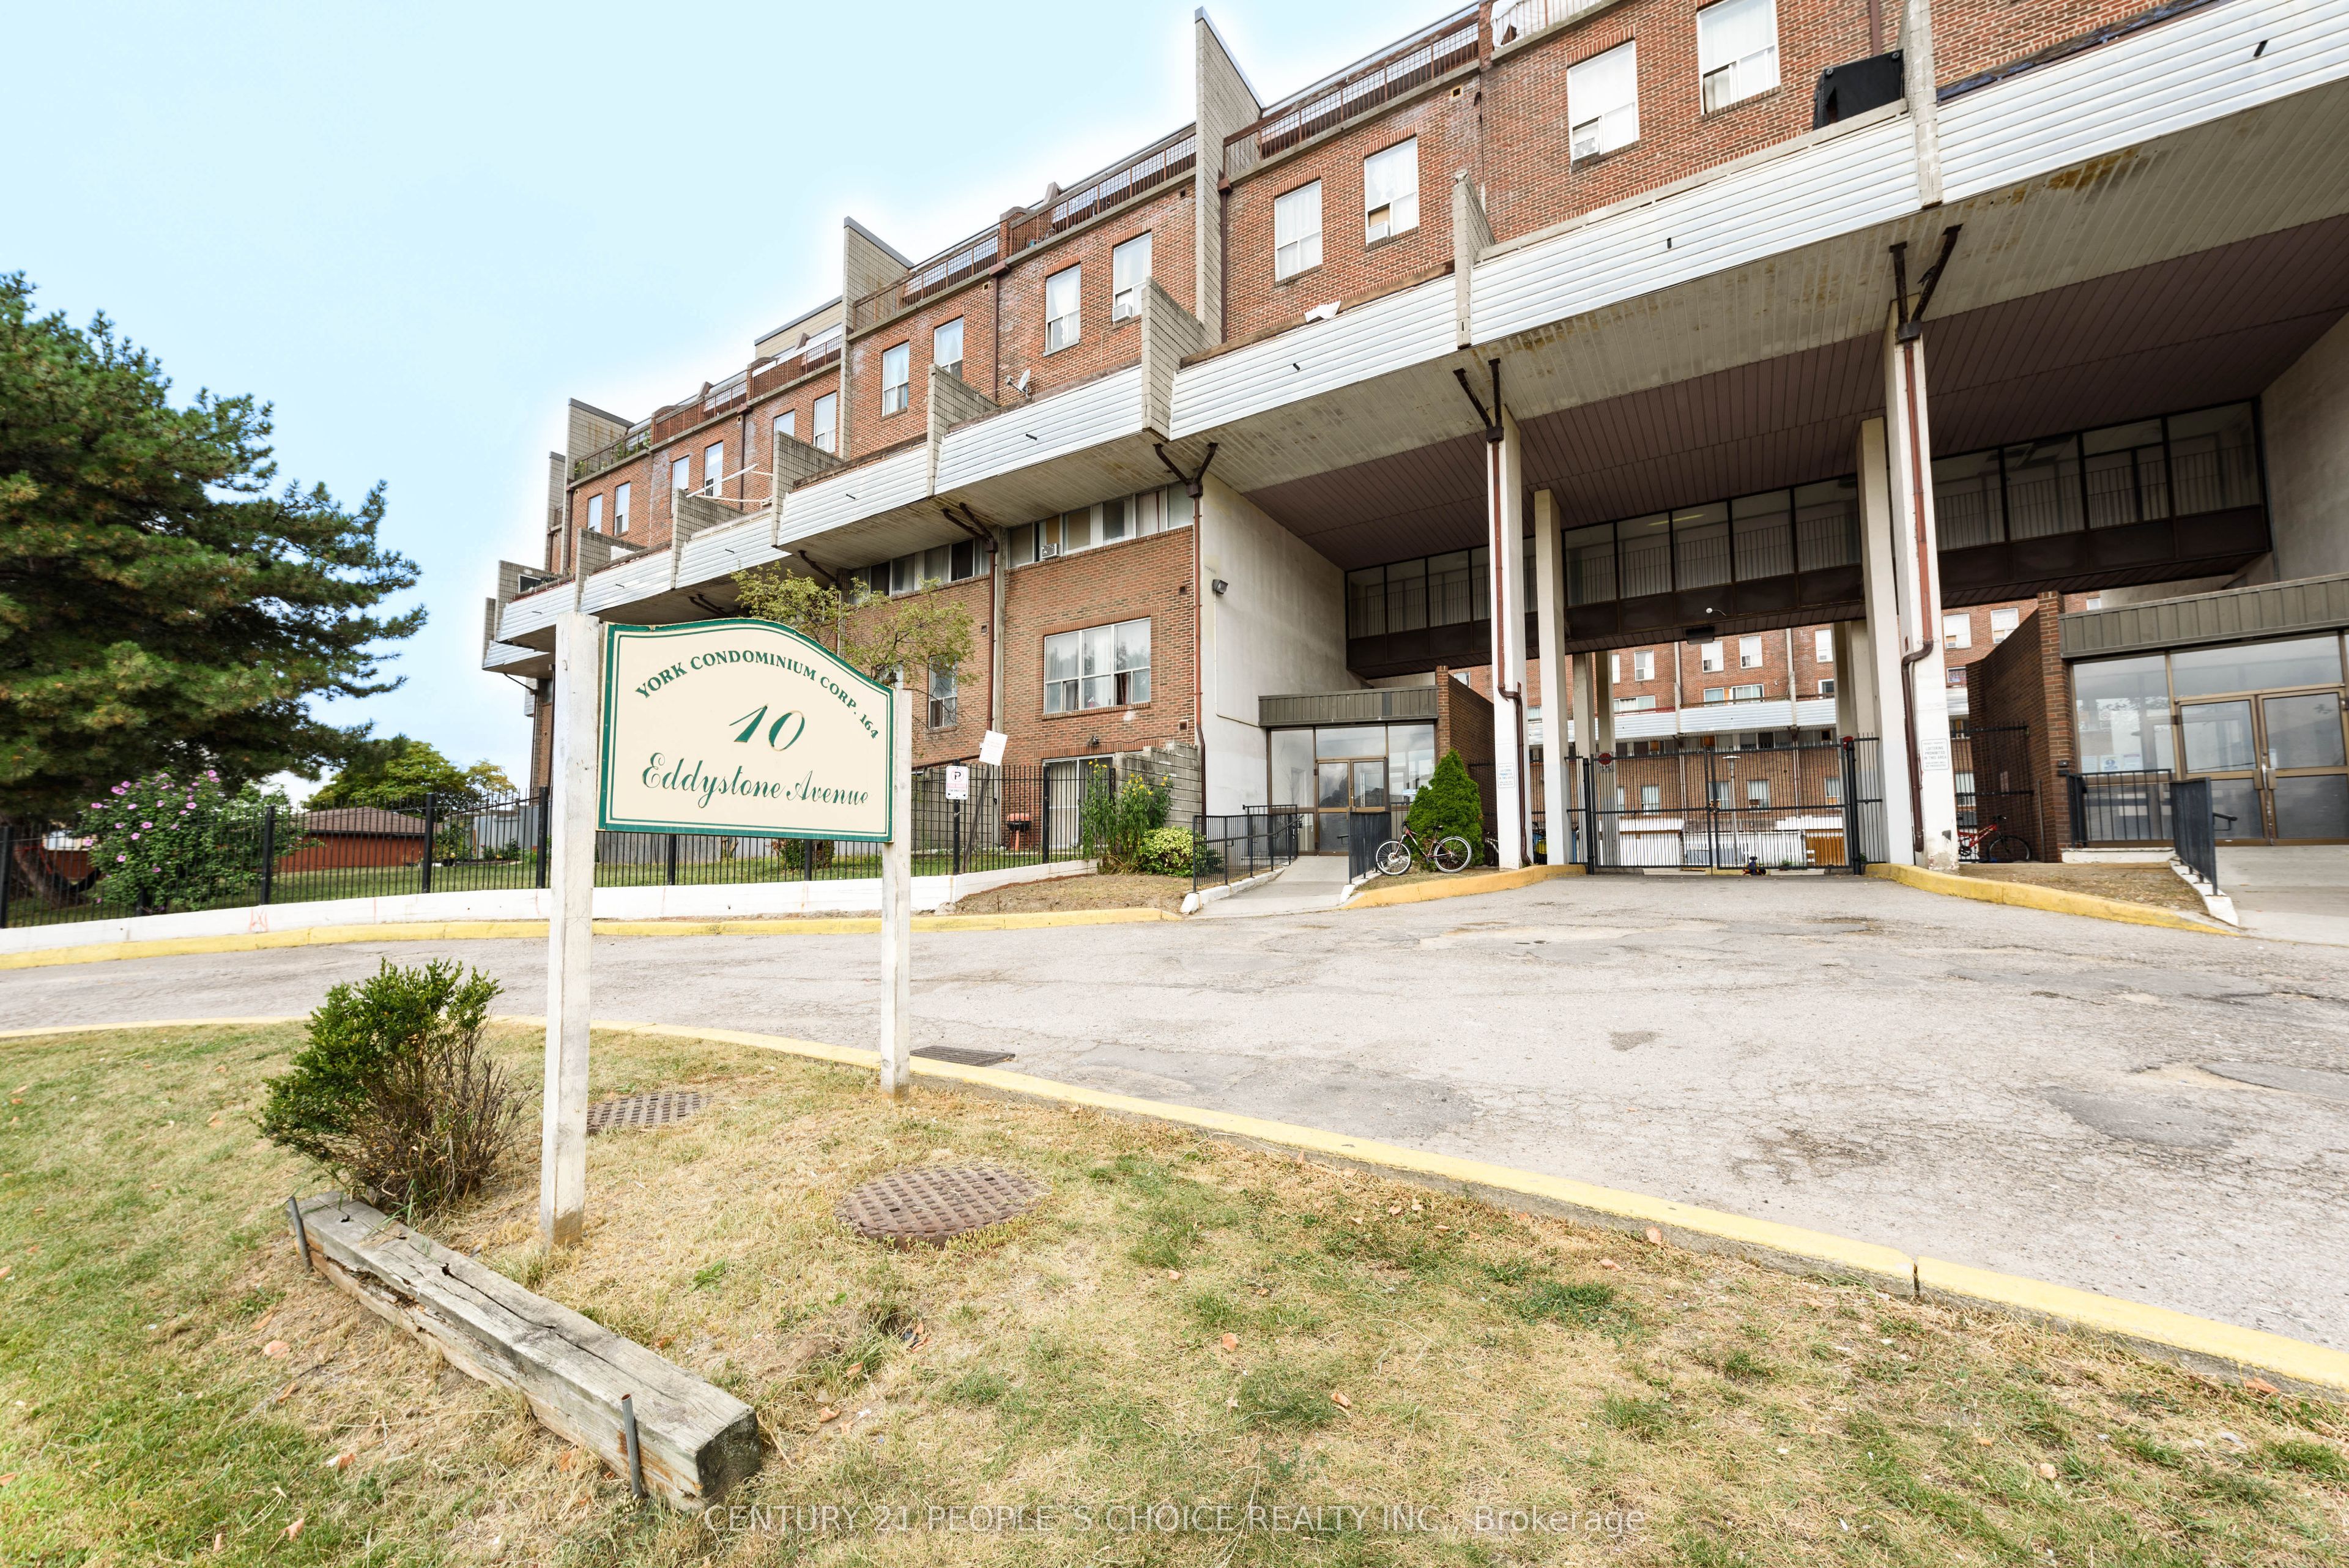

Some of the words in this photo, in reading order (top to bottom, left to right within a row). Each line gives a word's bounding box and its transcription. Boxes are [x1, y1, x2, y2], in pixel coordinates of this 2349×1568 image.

[635, 662, 688, 699] YORK
[690, 650, 817, 681] CONDOMINIUM
[820, 677, 856, 715] CORP.
[859, 713, 878, 739] 164
[729, 704, 805, 751] 10
[642, 752, 785, 808] Eddystone
[786, 770, 869, 805] Avenue
